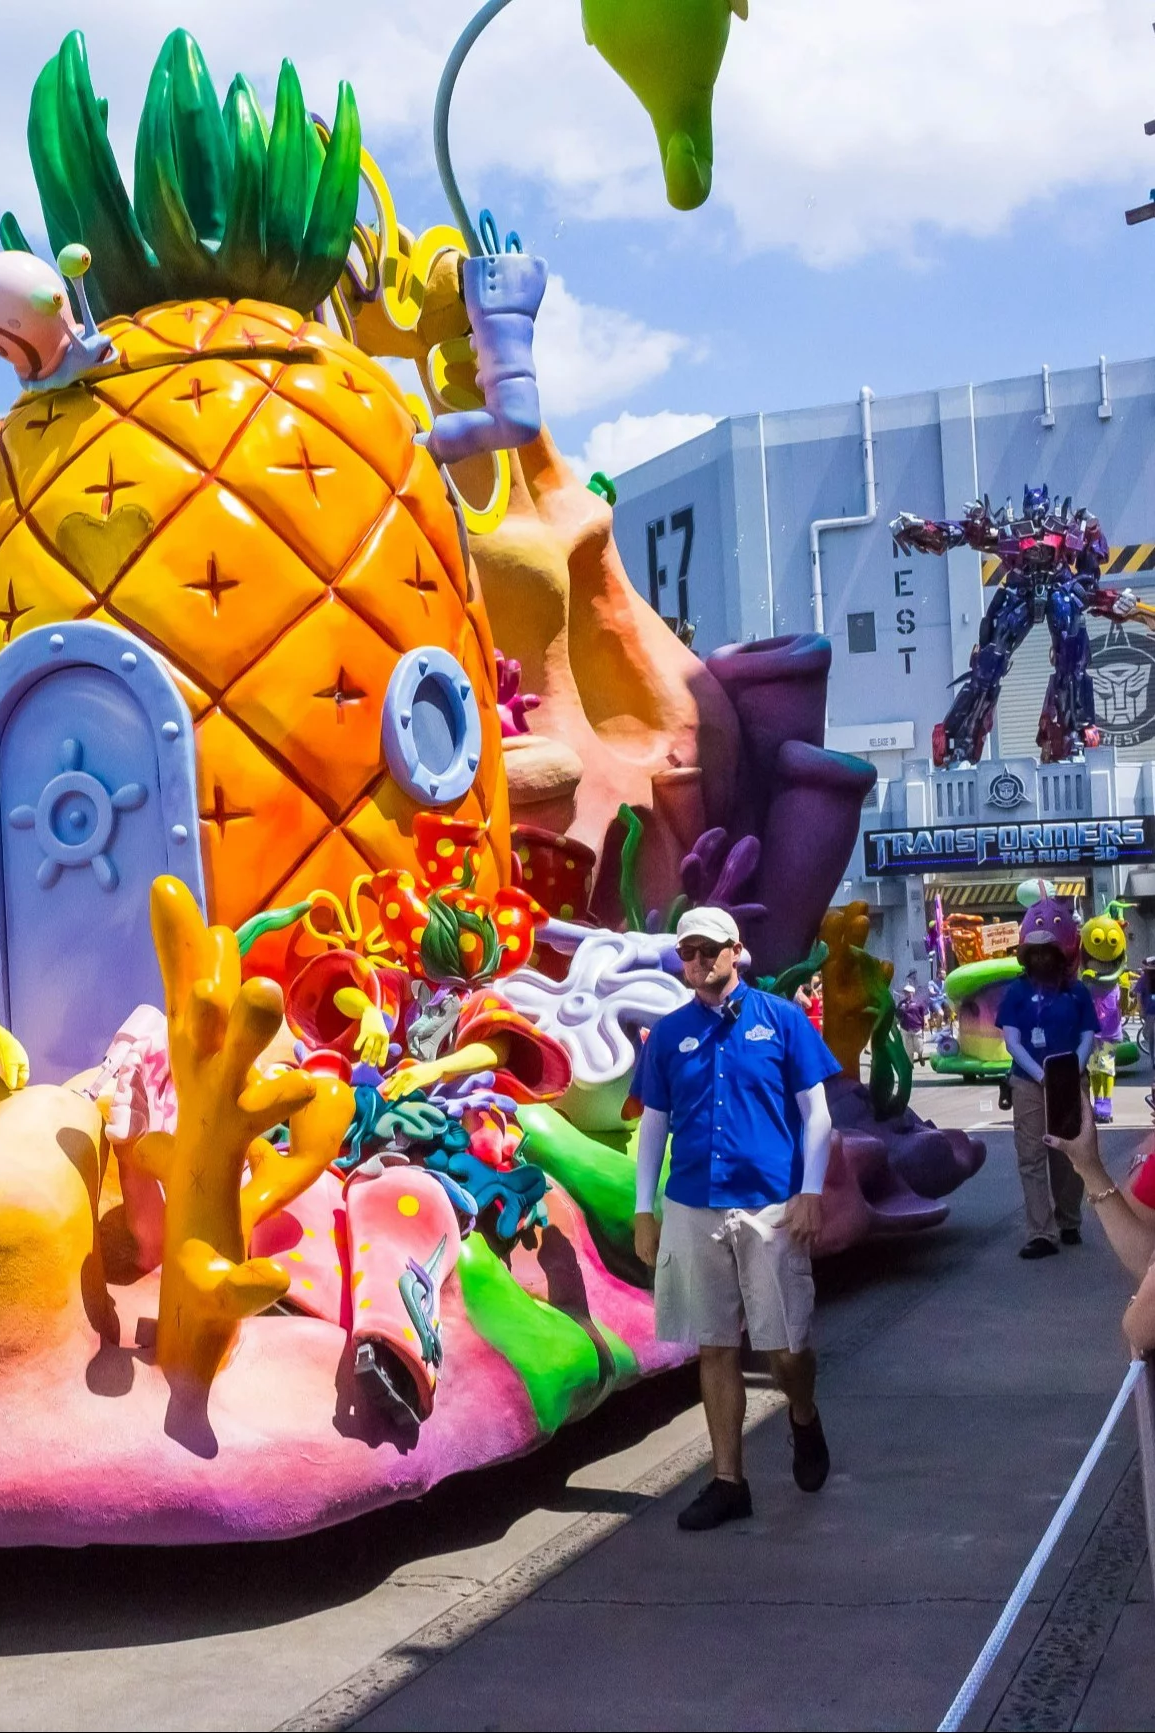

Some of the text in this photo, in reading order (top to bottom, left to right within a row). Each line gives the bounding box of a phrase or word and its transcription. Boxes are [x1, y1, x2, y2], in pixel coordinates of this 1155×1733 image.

[1103, 731, 1140, 746] NEST
[870, 819, 1144, 870] TRANSFORMERS
[1000, 851, 1035, 864] THE
